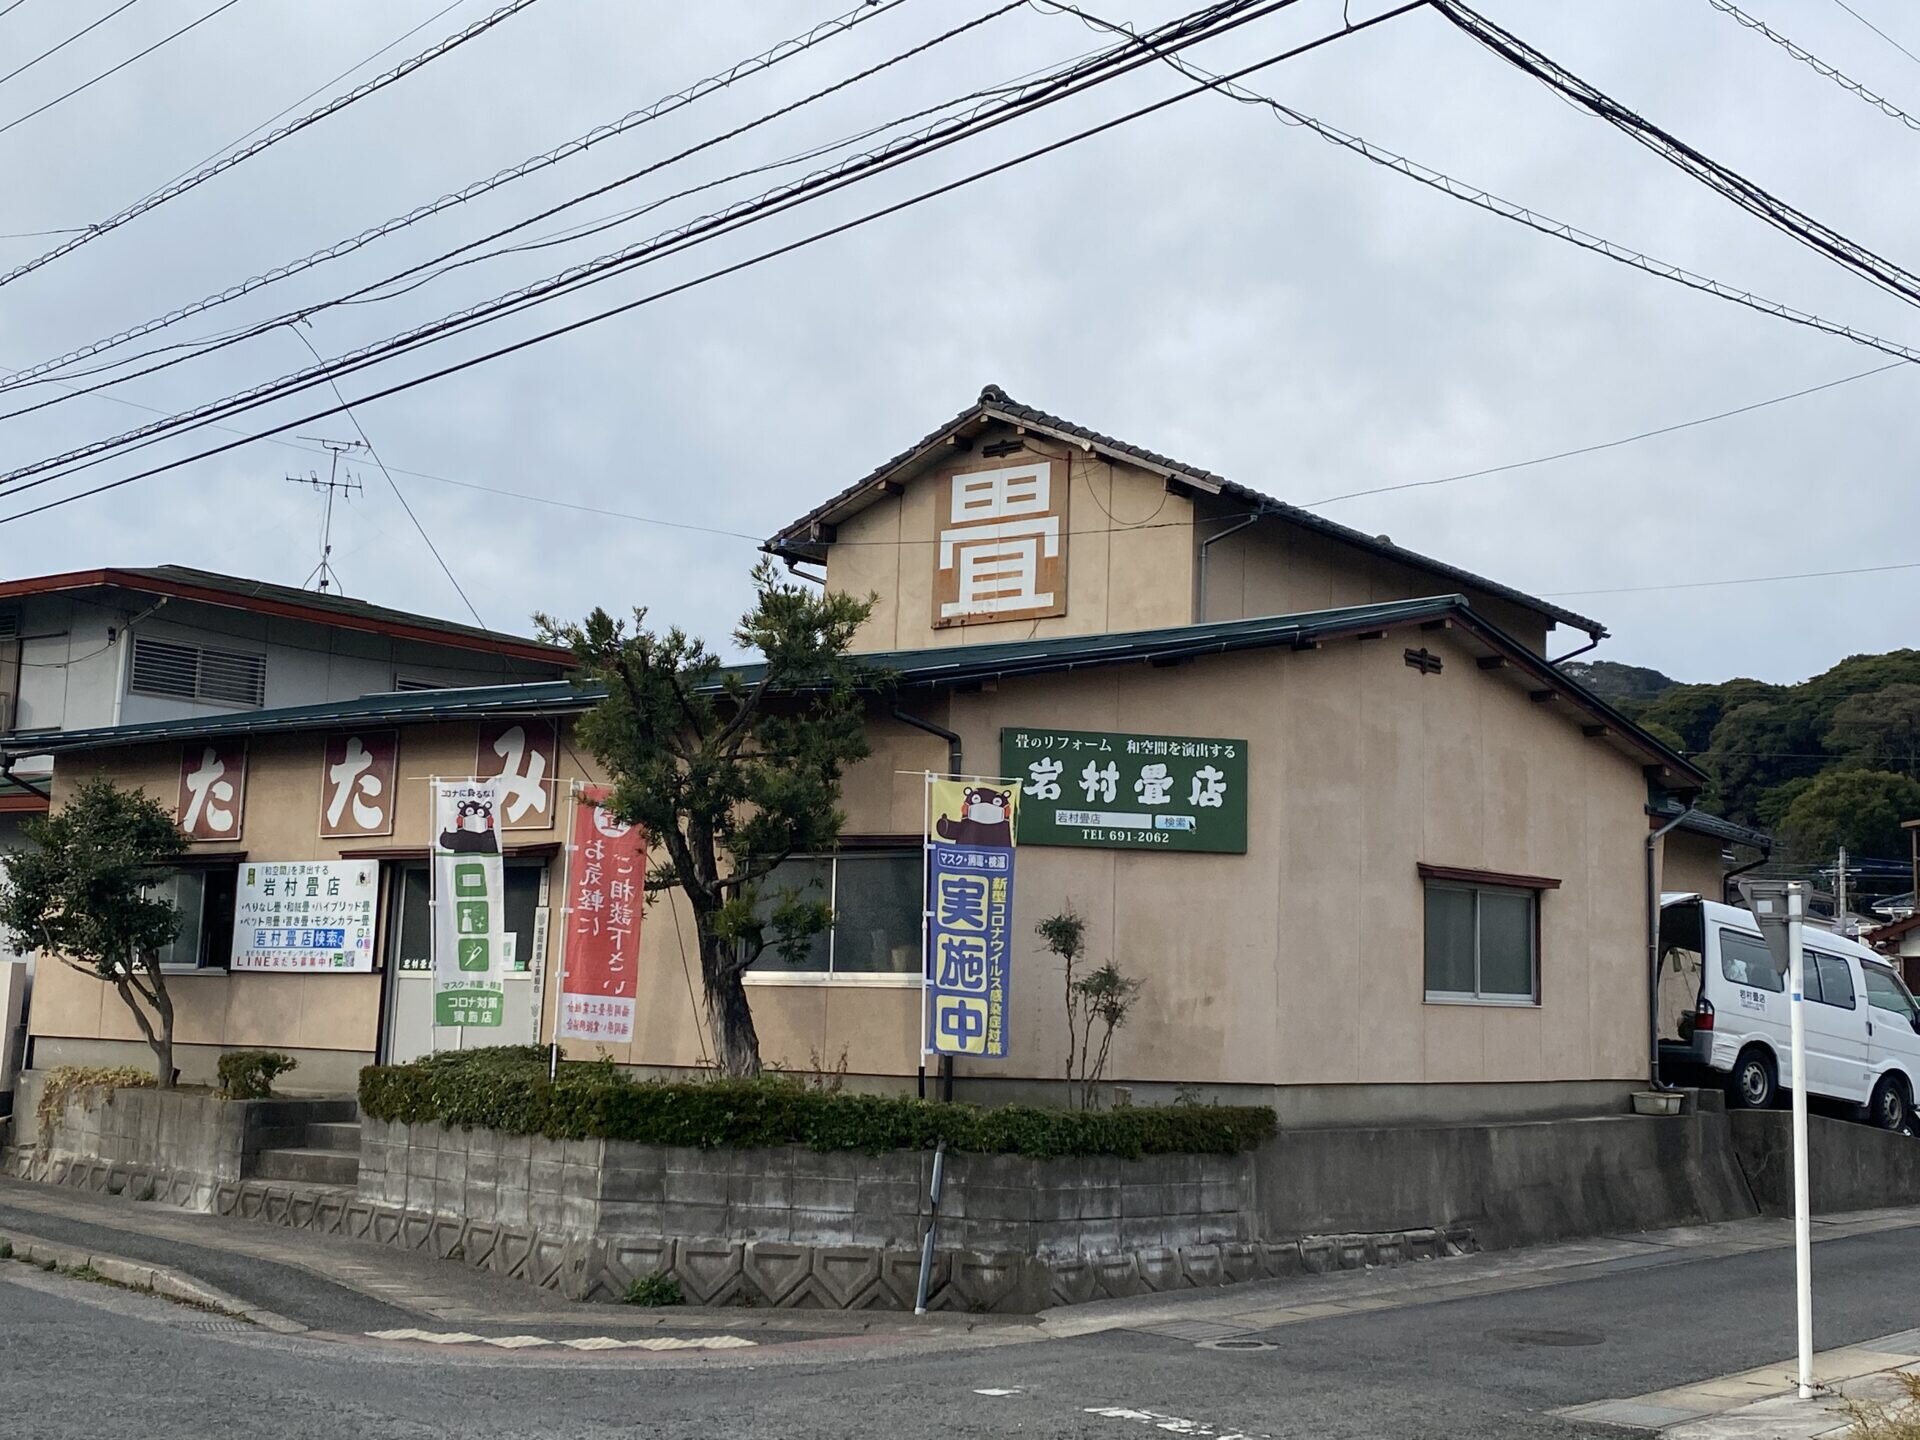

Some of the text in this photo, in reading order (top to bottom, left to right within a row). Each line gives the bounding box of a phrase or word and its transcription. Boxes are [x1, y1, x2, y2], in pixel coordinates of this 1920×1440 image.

[939, 461, 1059, 618] 畳
[1015, 733, 1236, 759] 畳のリフォーム 和空間を演出する
[1023, 756, 1227, 808] 岩村畳店
[1057, 812, 1186, 828] 岩村畳店 検索
[1081, 829, 1170, 843] TEL 691-2062
[263, 877, 341, 897] 岩村畳店
[255, 930, 337, 947] 岩村畳店 検索
[940, 876, 985, 1050] 実施中
[987, 876, 1008, 1055] 新型コロナウイルス感染症対策
[447, 997, 498, 1009] コロナ対策
